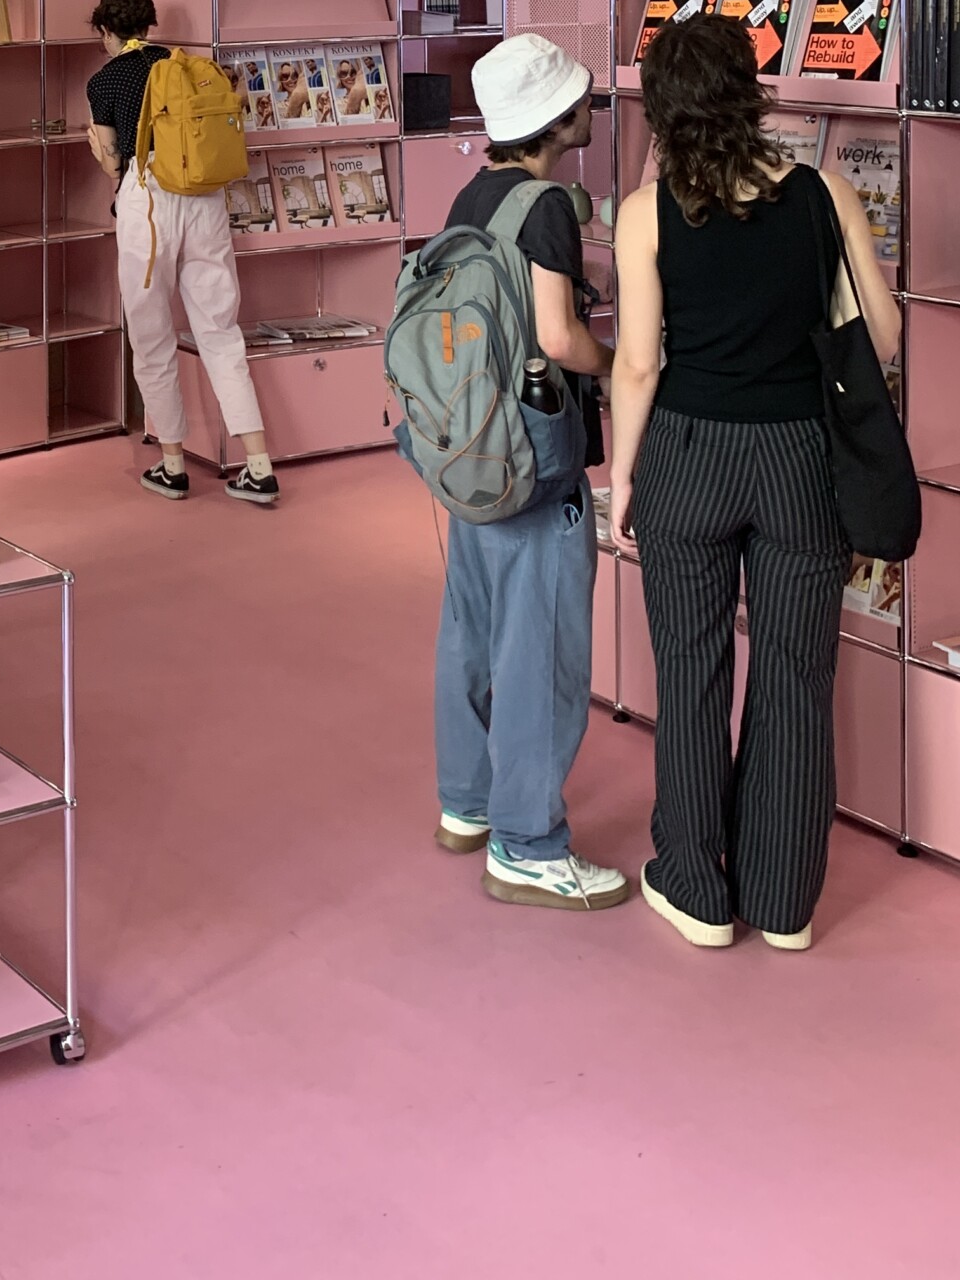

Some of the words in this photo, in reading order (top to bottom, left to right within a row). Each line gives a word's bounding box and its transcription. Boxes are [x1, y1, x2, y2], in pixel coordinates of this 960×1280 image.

[810, 36, 838, 49] How
[842, 37, 855, 50] to
[220, 49, 258, 60] ONFEKT
[272, 48, 317, 58] KONFEKT
[331, 45, 375, 55] KONFEKT
[806, 50, 856, 64] Rebuild
[836, 145, 884, 165] work
[272, 164, 305, 177] home
[330, 160, 363, 172] home
